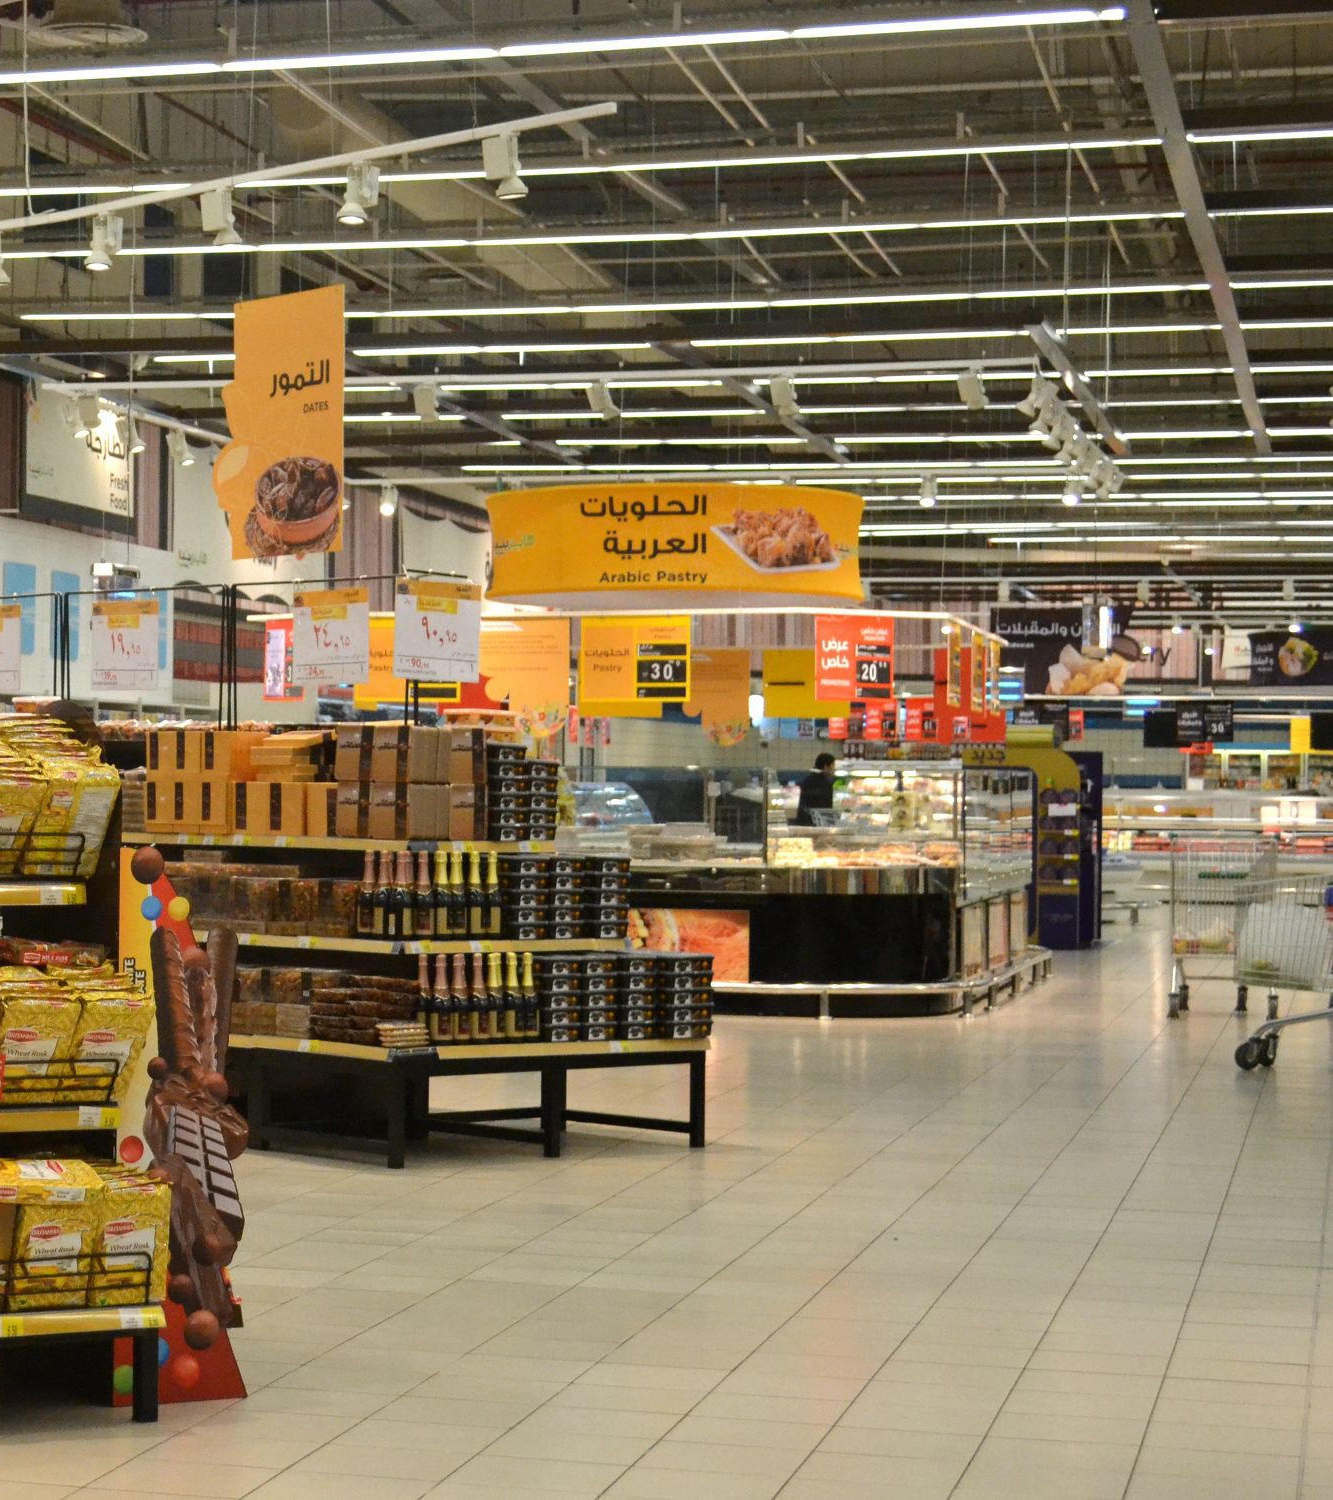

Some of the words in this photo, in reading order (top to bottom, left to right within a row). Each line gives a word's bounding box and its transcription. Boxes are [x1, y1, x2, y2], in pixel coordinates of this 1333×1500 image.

[270, 358, 330, 398] التمور
[303, 400, 329, 414] DATES
[110, 493, 127, 511] Food
[580, 494, 707, 522] الحلويات
[603, 530, 707, 560] العربية
[599, 572, 650, 583] Arabic
[657, 571, 707, 584] Pastry
[821, 636, 850, 653] عرض
[585, 648, 630, 659] الحلويات
[593, 664, 623, 673] Pastry
[821, 655, 850, 670] خاص
[7, 1049, 31, 1057] Wheat
[34, 1247, 57, 1255] Wheat
[59, 1245, 76, 1254] Rusk
[109, 1244, 132, 1252] Wheat
[133, 1242, 150, 1251] Rusk
